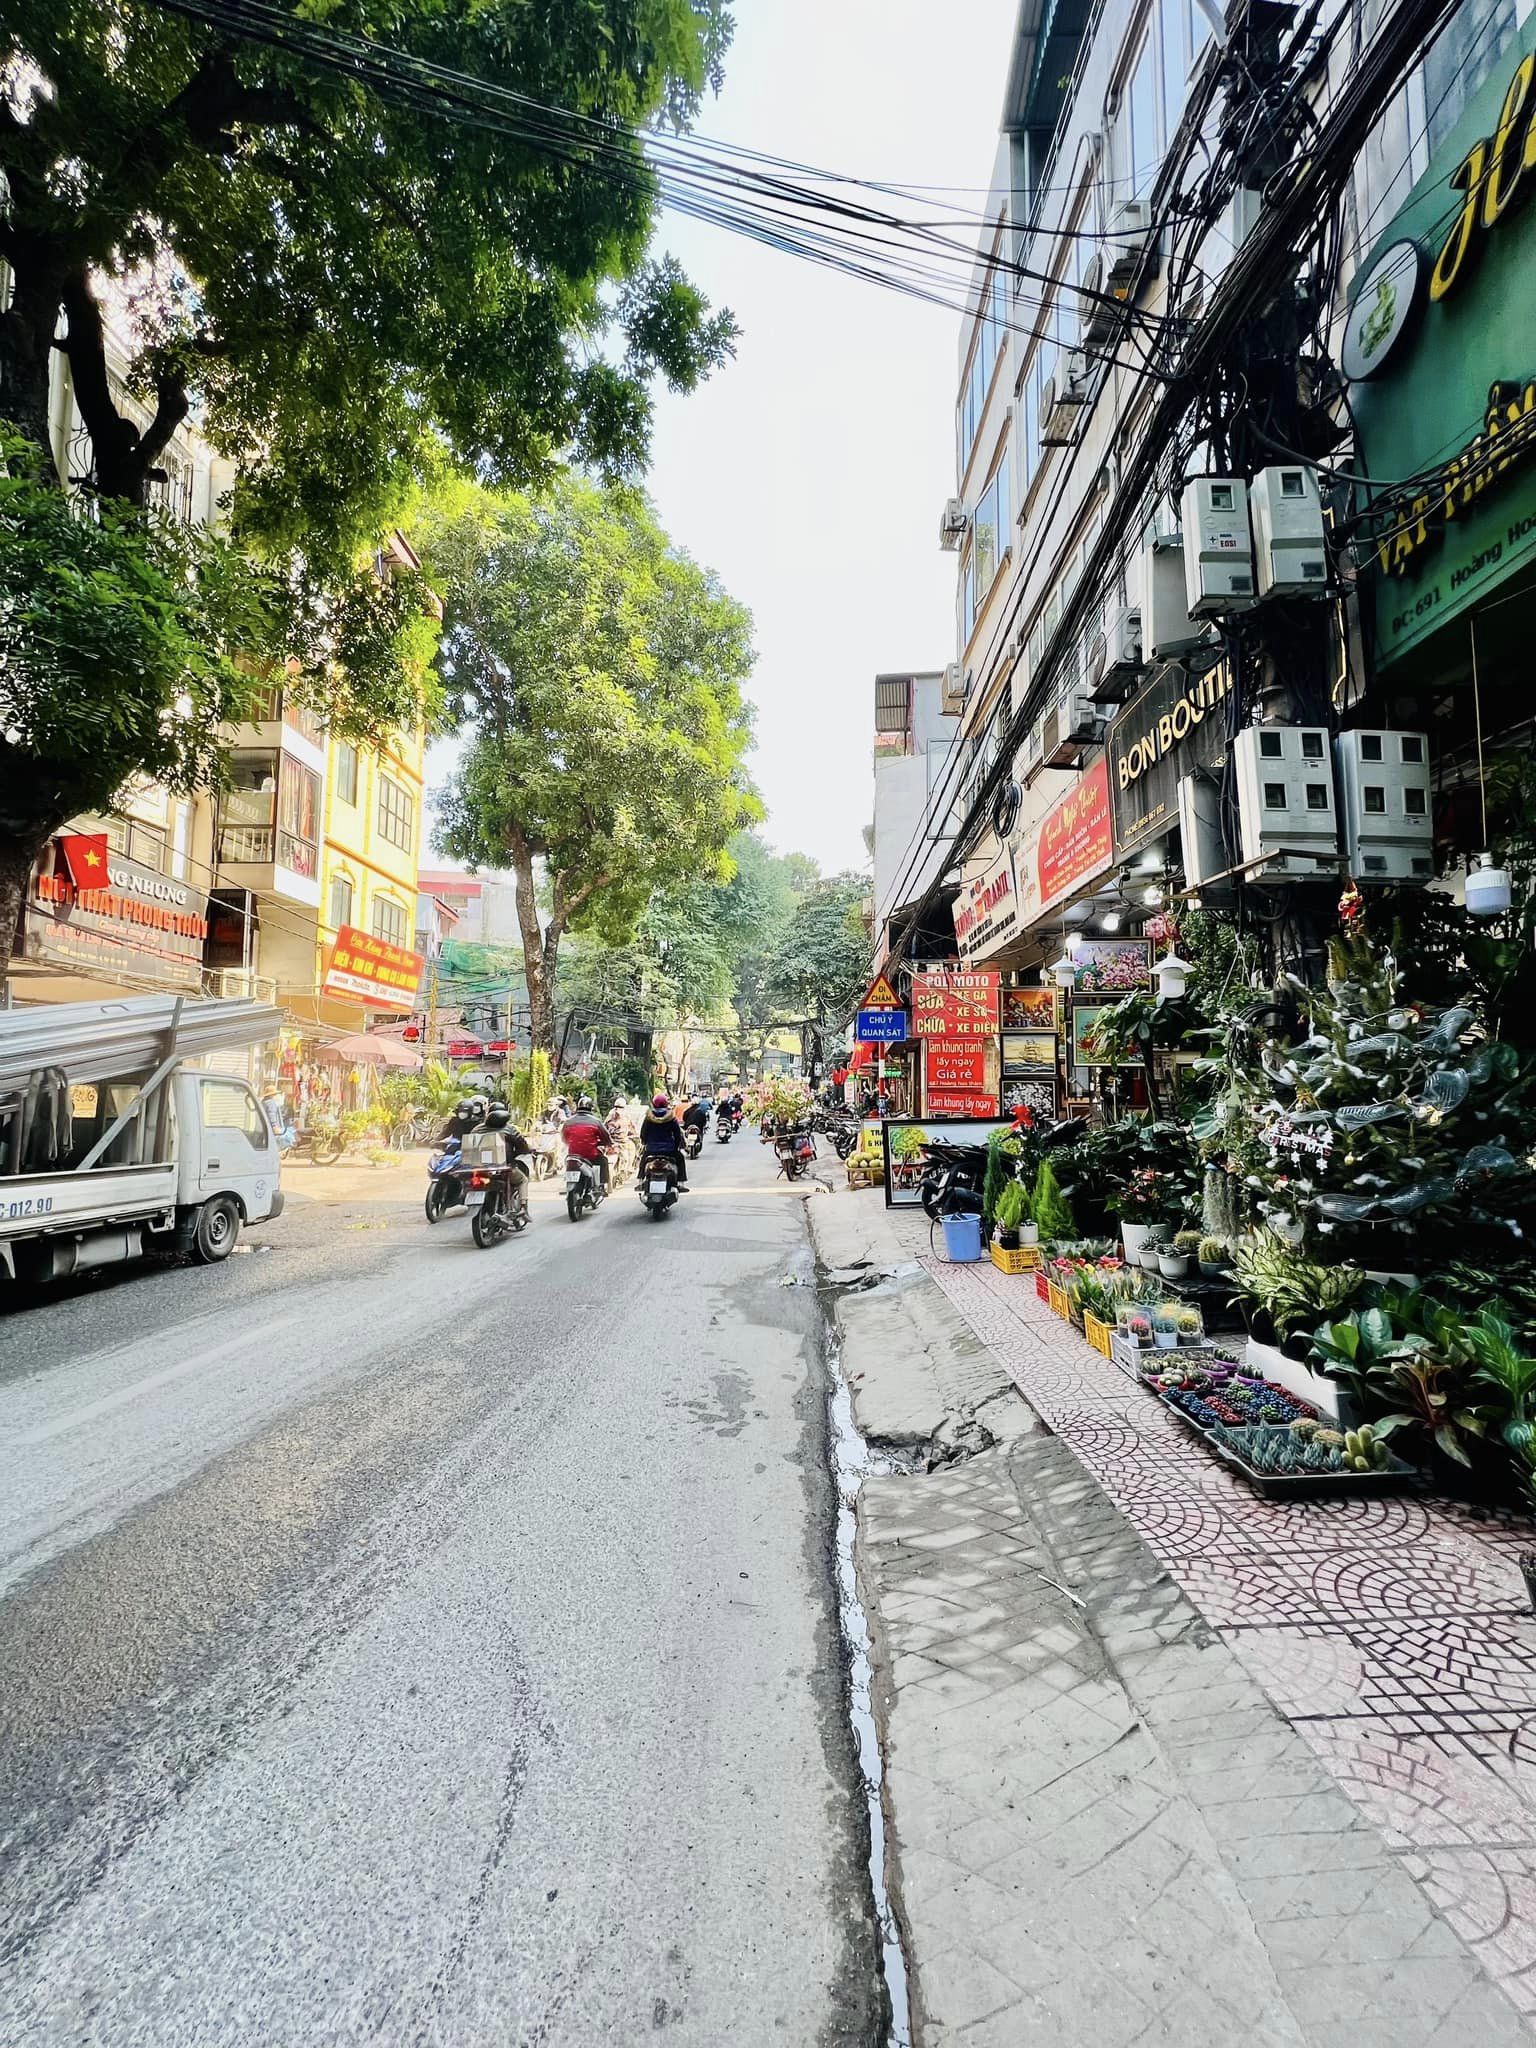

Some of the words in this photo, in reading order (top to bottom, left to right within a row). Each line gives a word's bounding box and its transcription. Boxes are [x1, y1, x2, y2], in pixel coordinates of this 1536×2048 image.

[1450, 541, 1502, 590] Hoàng
[1119, 728, 1157, 791] BON
[129, 874, 187, 905] NHUNG
[953, 975, 989, 987] MOTO
[973, 991, 987, 1000] GA
[956, 1007, 970, 1017] XE
[888, 1014, 894, 1024] Ý
[917, 1015, 946, 1033] CHỮA
[862, 1028, 885, 1037] QUAN
[886, 1027, 902, 1037] SÁT
[956, 1023, 970, 1033] XE
[973, 1020, 999, 1036] ĐIỆN
[942, 1040, 964, 1056] khung
[965, 1040, 983, 1053] tranh
[936, 1056, 949, 1067] lấy
[951, 1058, 975, 1067] ngay
[936, 1069, 957, 1079] Giá
[960, 1069, 973, 1079] rẻ
[930, 1096, 943, 1107] Làm
[944, 1096, 964, 1110] khung
[965, 1096, 974, 1110] lấy
[975, 1100, 992, 1111] ngay
